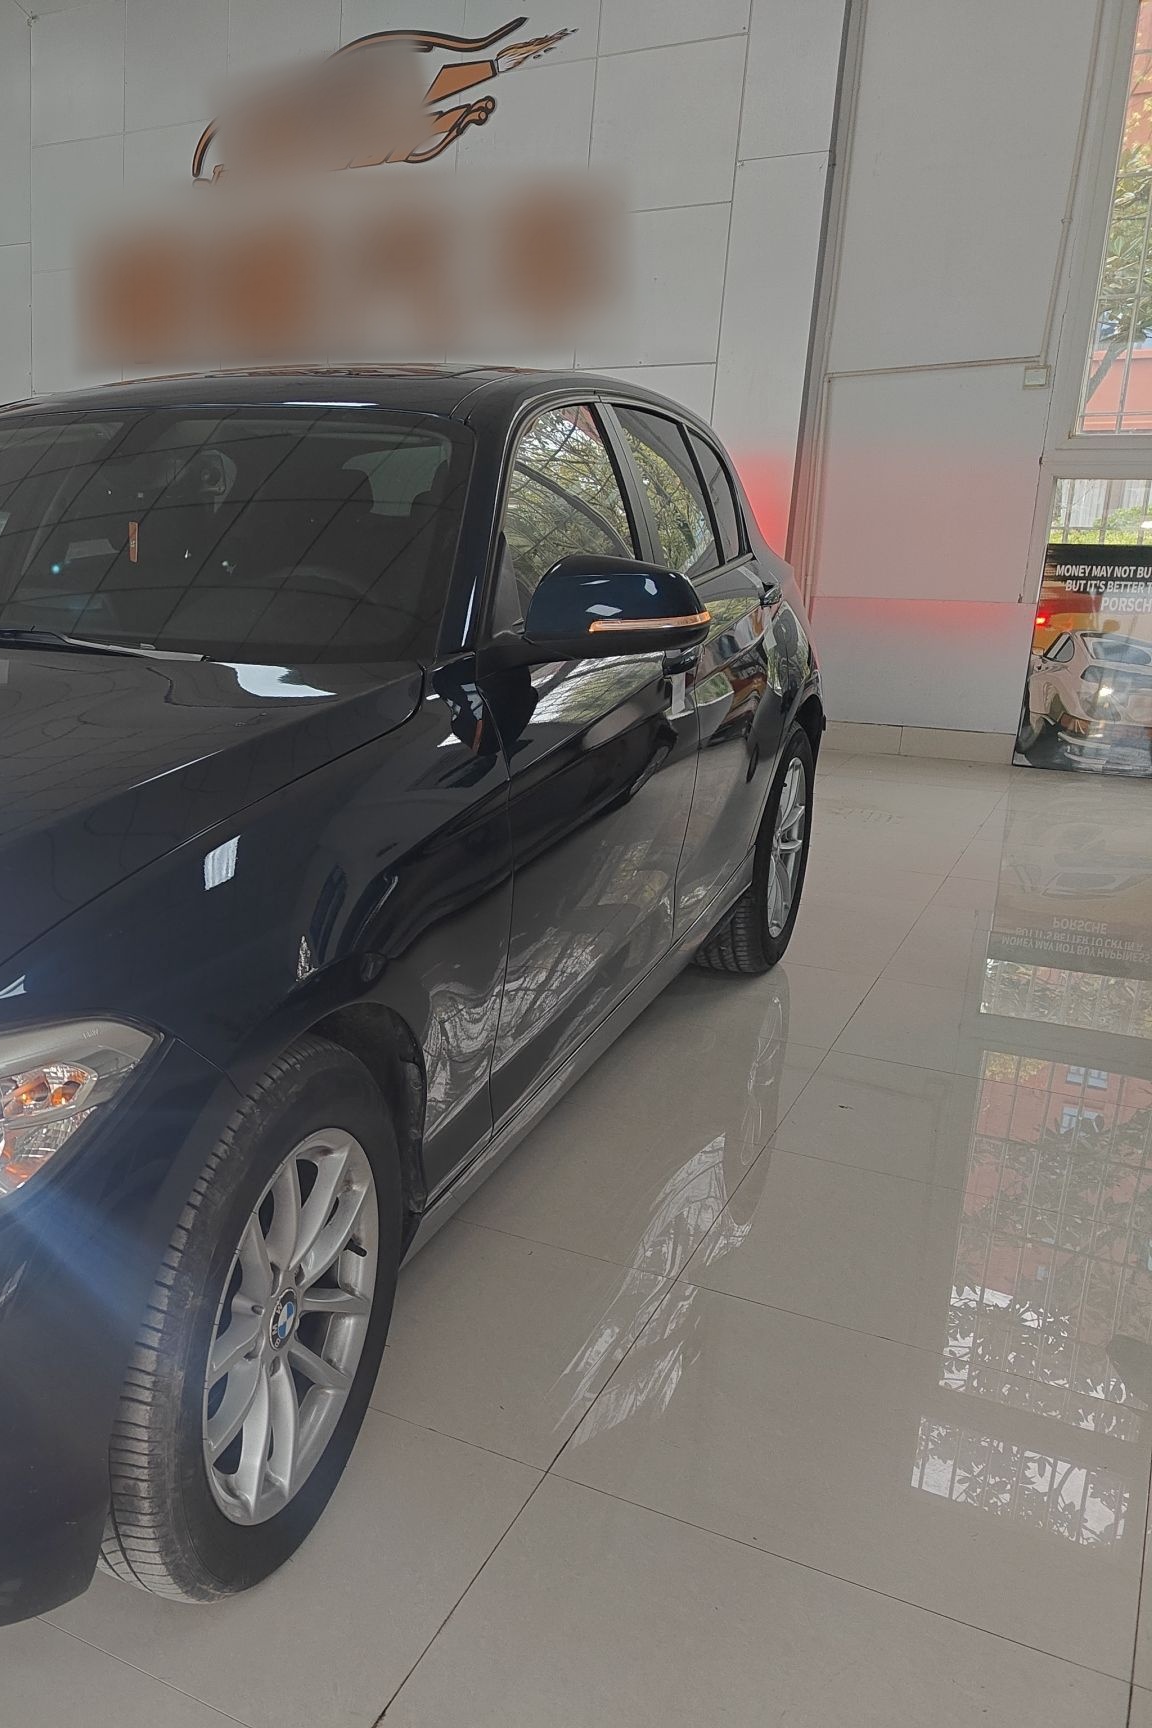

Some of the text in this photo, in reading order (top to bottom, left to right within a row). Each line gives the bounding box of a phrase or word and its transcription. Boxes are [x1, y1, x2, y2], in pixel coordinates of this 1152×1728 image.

[1056, 565, 1152, 578] MONEY MAY NOT BU
[1065, 580, 1086, 592] BUT
[1087, 580, 1106, 592] IT'S
[1107, 581, 1145, 593] BETTER
